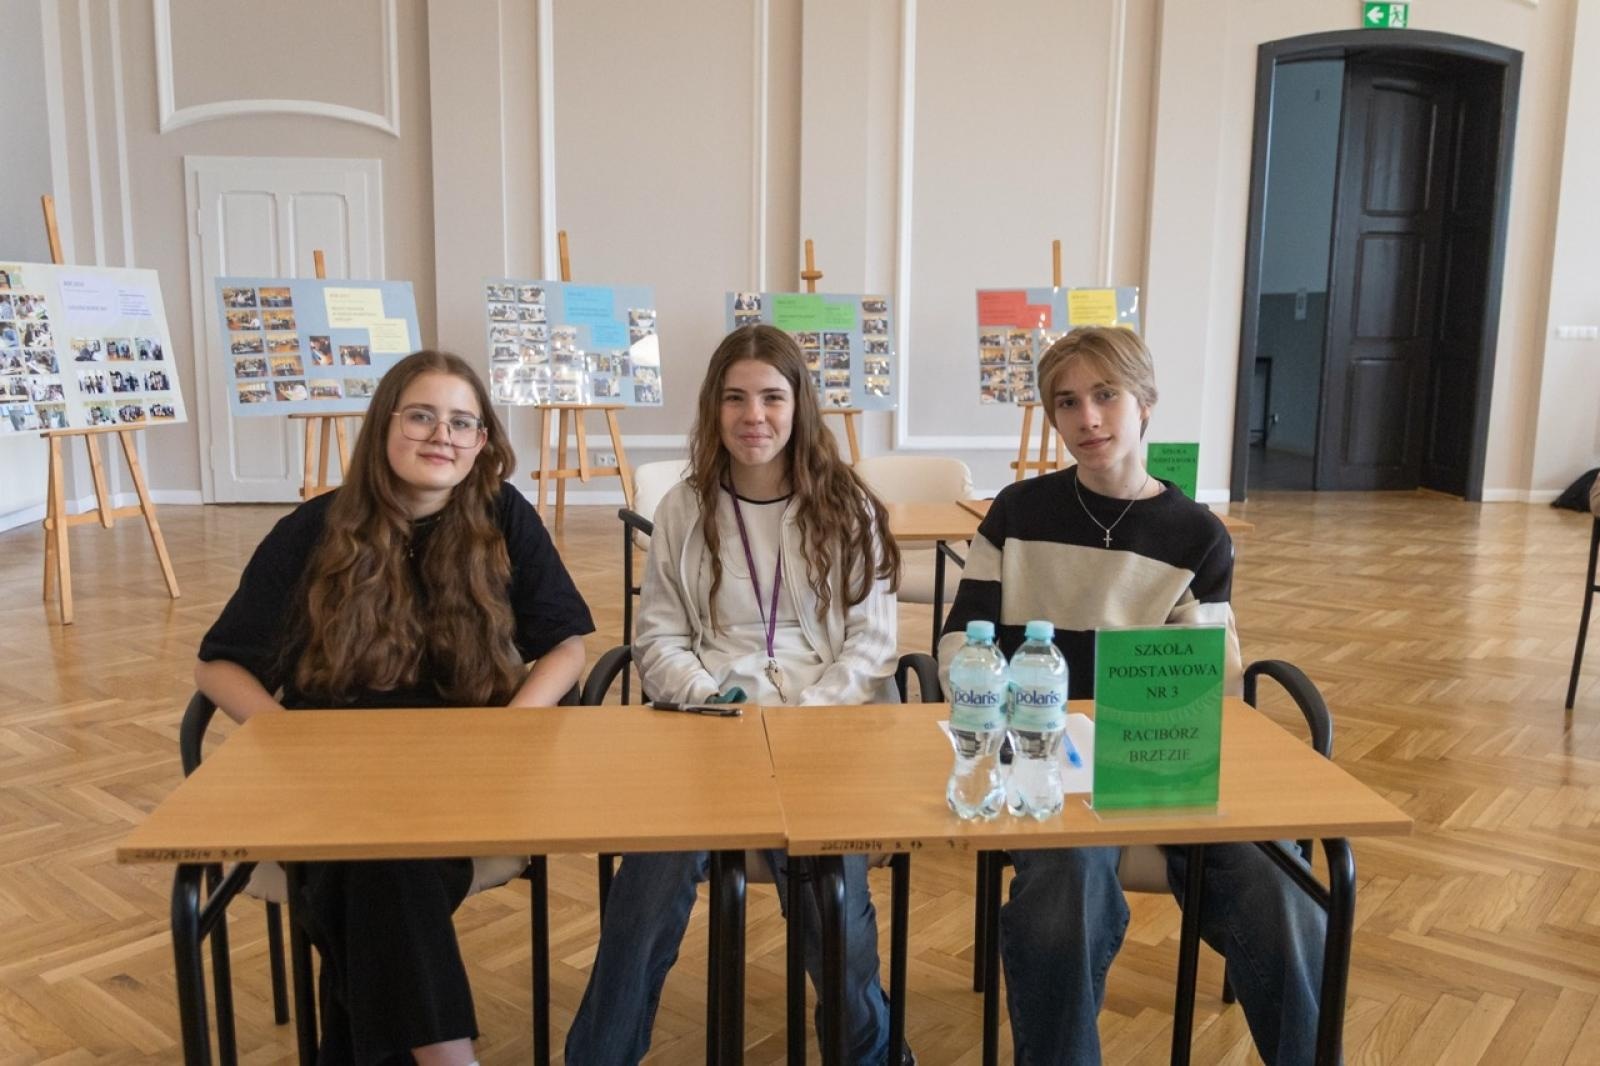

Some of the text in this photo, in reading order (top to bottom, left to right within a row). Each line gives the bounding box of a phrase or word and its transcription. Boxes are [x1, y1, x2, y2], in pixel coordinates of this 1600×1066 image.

[1134, 643, 1194, 657] SZKOŁA
[1109, 664, 1217, 679] PODSTAWOWA
[1147, 685, 1179, 699] NR 3
[1122, 724, 1199, 742] RACIBÓRZ
[1129, 748, 1191, 763] BRZEZIE
